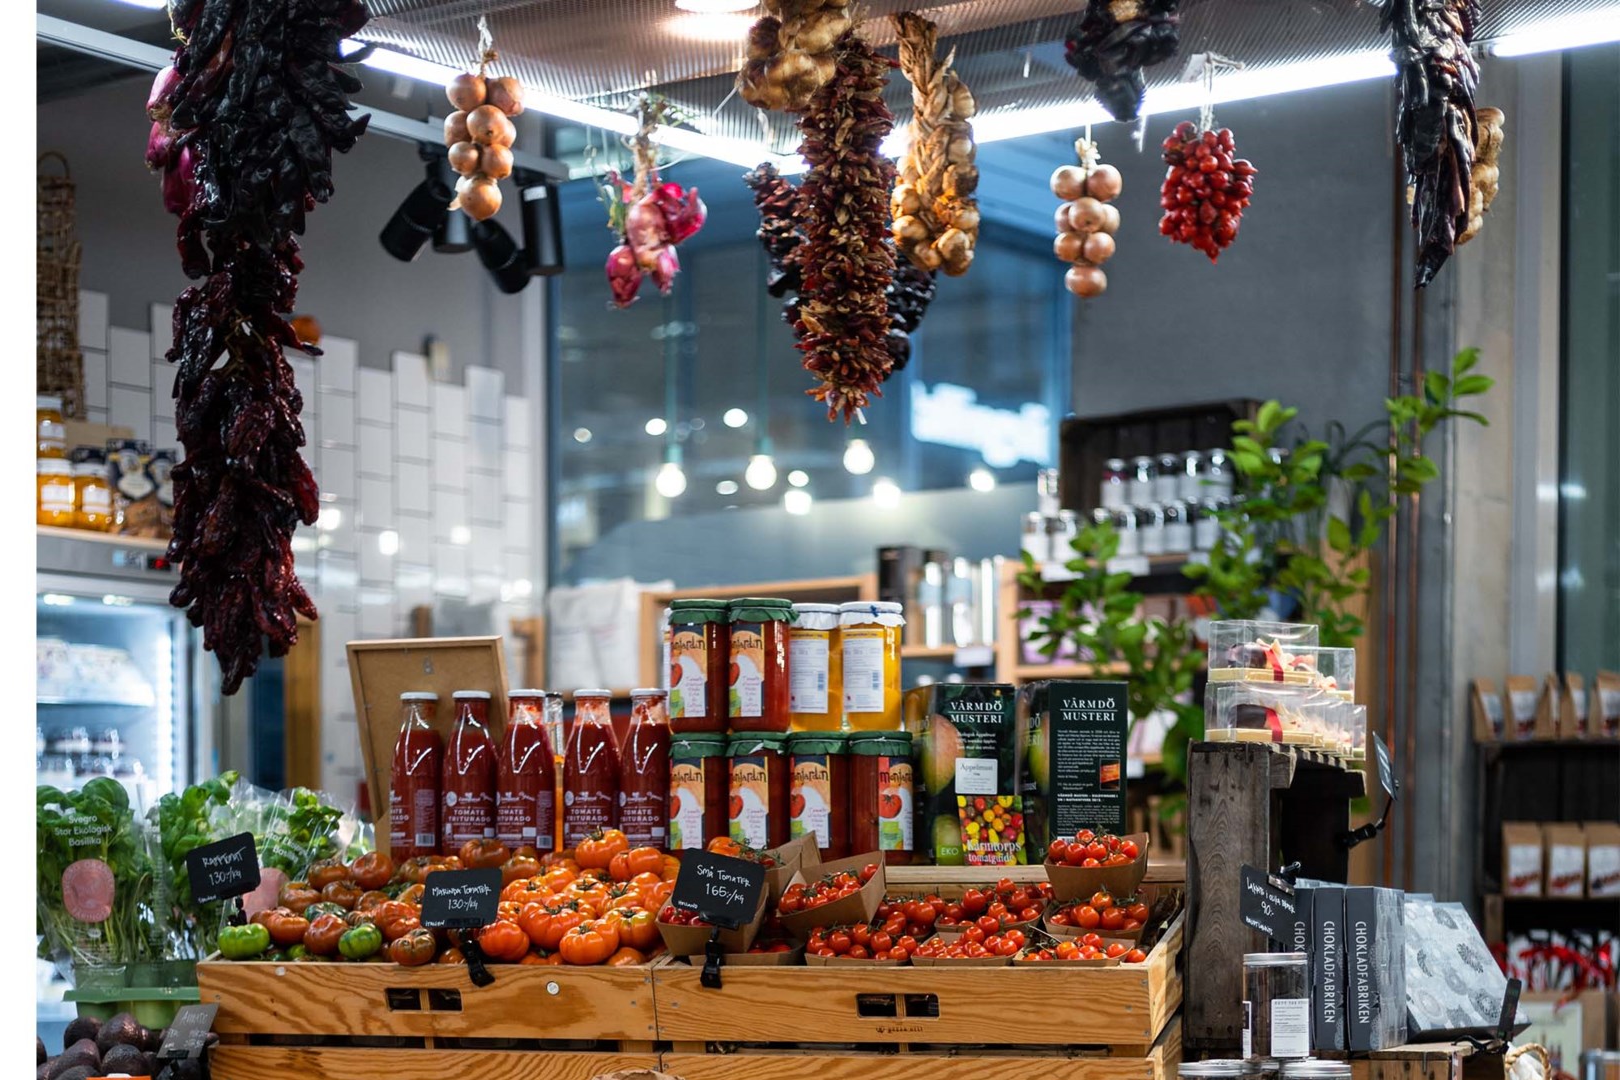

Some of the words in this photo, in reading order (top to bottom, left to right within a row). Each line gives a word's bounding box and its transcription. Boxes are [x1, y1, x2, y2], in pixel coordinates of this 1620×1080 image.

[951, 700, 1002, 711] VÄRMDÖ
[1063, 697, 1115, 709] VÄRMDÖ
[950, 714, 1002, 724] MUSTERI
[1063, 712, 1115, 721] MUSTERI
[68, 815, 98, 825] Svegro
[54, 827, 72, 836] Stor
[73, 824, 113, 835] Ekologisk
[68, 837, 102, 847] Basilika
[941, 847, 959, 856] EKO
[1323, 920, 1336, 1023] CHOKLADFABRIKEN
[1355, 921, 1370, 1024] CHOKLADFABRIKEN
